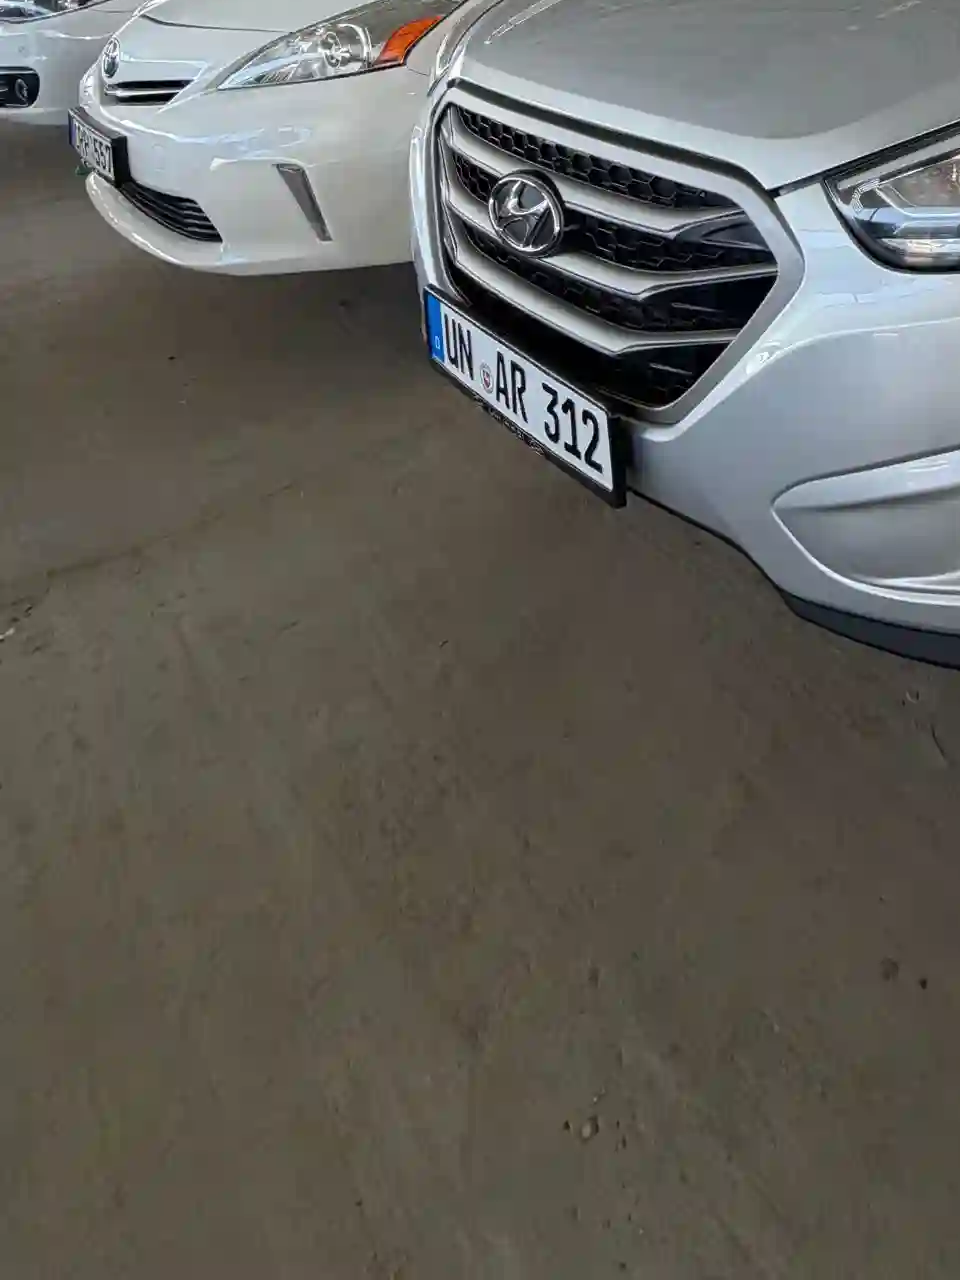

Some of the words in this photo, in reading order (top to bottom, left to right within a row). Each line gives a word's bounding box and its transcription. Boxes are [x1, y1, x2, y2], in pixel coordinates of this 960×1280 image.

[443, 312, 475, 381] UN
[495, 349, 529, 424] AR
[541, 382, 604, 474] 312
